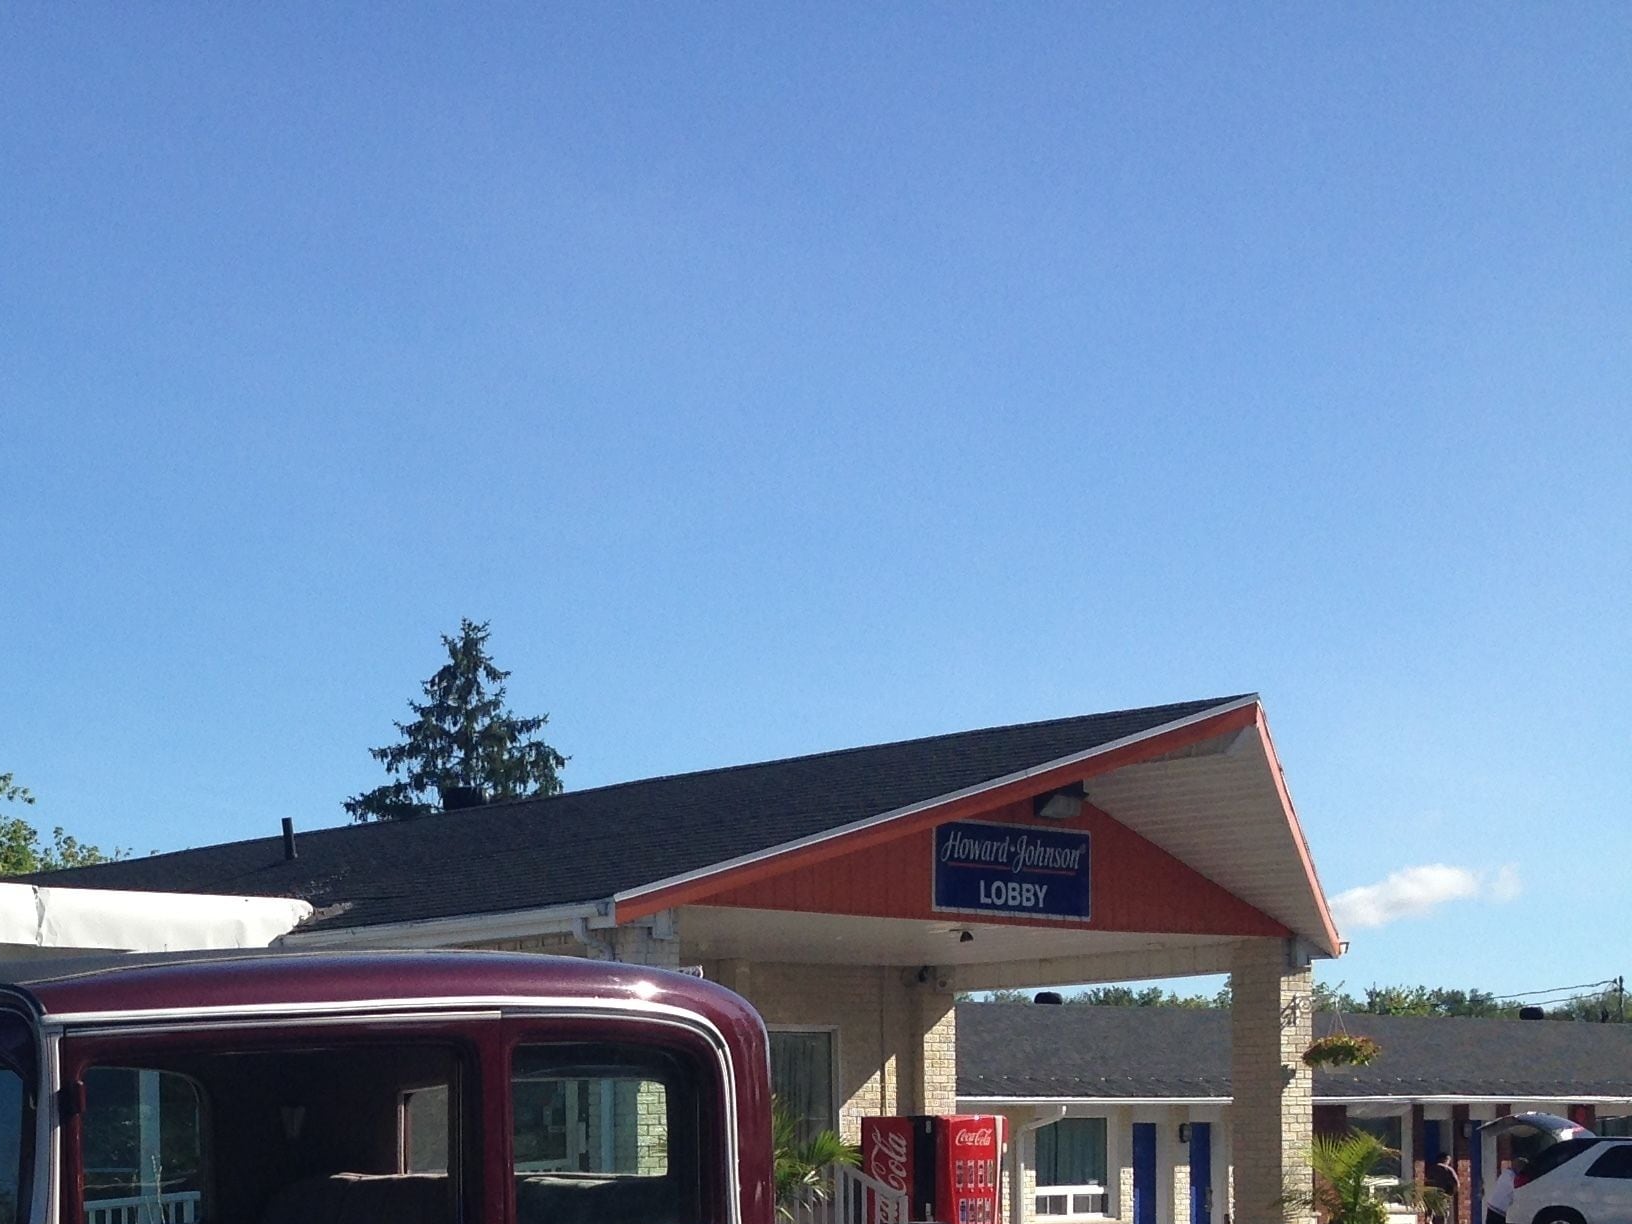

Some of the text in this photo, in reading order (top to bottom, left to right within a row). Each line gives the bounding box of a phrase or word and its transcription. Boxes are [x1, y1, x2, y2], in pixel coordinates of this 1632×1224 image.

[941, 831, 1081, 873] Howard Johnson
[979, 879, 1048, 908] LOBBY
